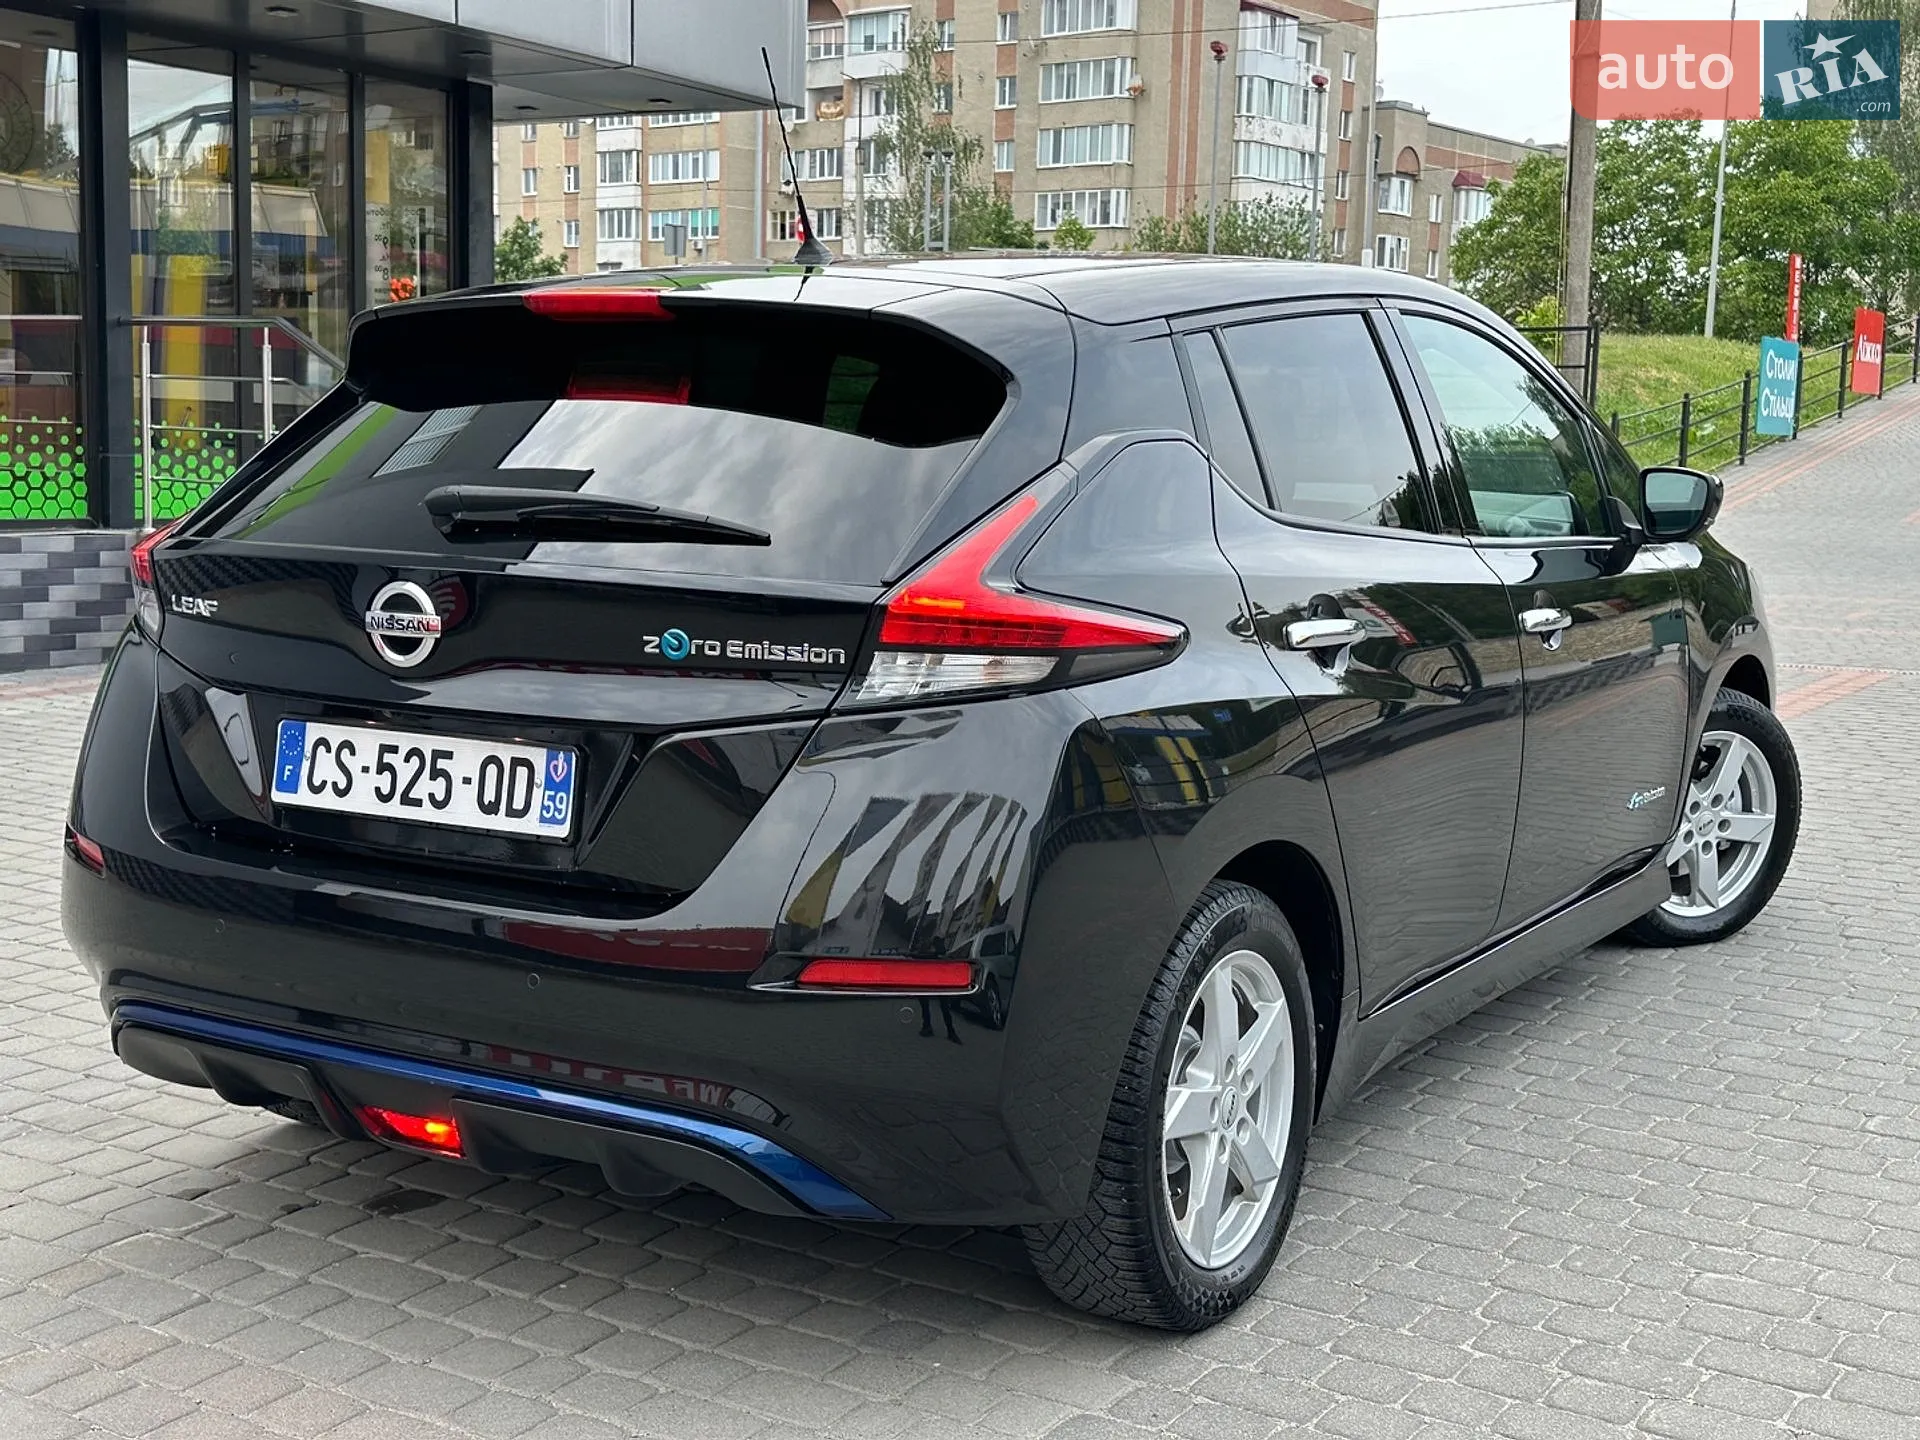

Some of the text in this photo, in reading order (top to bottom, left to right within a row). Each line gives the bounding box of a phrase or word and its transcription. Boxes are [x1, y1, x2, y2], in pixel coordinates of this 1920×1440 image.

[1766, 349, 1796, 381] Столи
[172, 594, 218, 617] LEAF
[369, 614, 431, 633] NISSAN
[726, 639, 846, 665] Emission
[282, 736, 567, 821] F CS-525-QD 59
